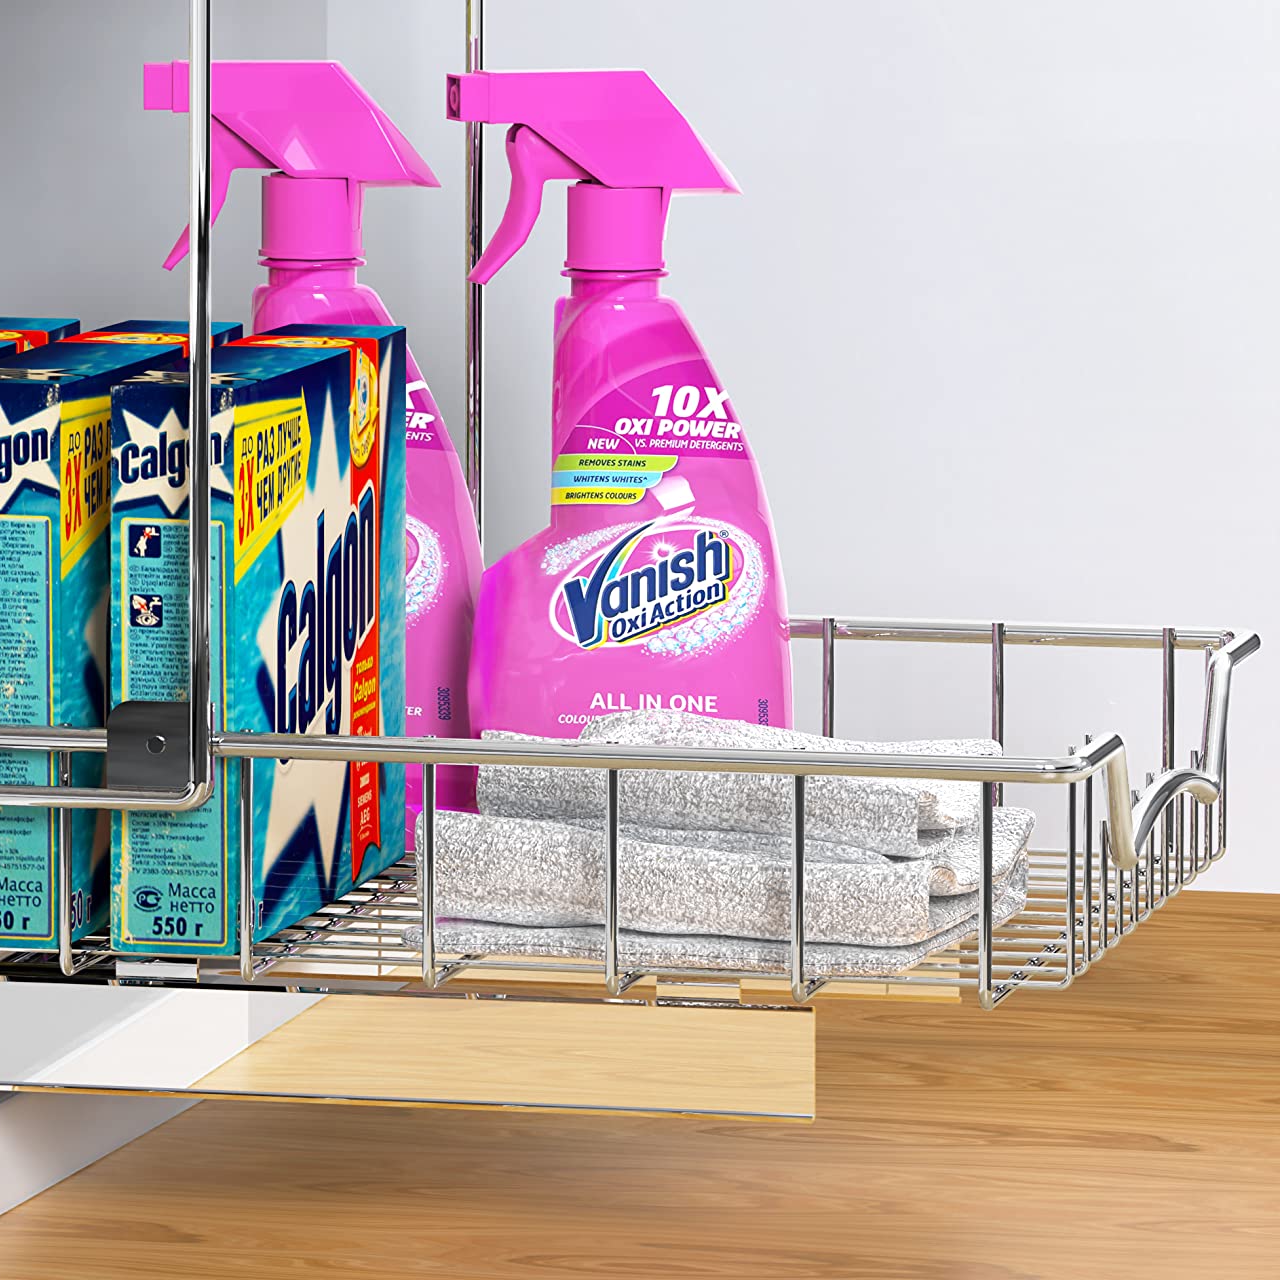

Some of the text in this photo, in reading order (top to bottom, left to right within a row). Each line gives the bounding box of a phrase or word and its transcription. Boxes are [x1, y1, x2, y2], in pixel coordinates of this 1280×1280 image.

[652, 384, 730, 419] 10X
[615, 418, 741, 439] OXI POWER
[68, 432, 81, 456] ДО
[84, 422, 104, 469] РАЗ
[241, 436, 254, 458] ДО
[256, 415, 301, 474] РАЗ ЛУЧШЕ
[587, 438, 620, 450] NEW
[635, 438, 744, 452] VS. PREMIUM DETERGENTS
[121, 431, 222, 488] Calgn
[578, 459, 646, 468] REMOVES STAINS
[256, 451, 302, 523] ЧЕМ ДРУГИЕ
[573, 475, 610, 483] WHITENS
[84, 466, 104, 519] ЧЕМ
[565, 492, 637, 500] BRIGHTENS COLOURS
[563, 521, 723, 644] Vanish
[277, 486, 375, 765] Calgon
[353, 677, 376, 703] Calgon
[590, 692, 718, 713] ALL IN ONE
[168, 882, 217, 899] Масса
[170, 901, 215, 914] нетто
[22, 915, 31, 930] г
[152, 916, 204, 936] 550 г
